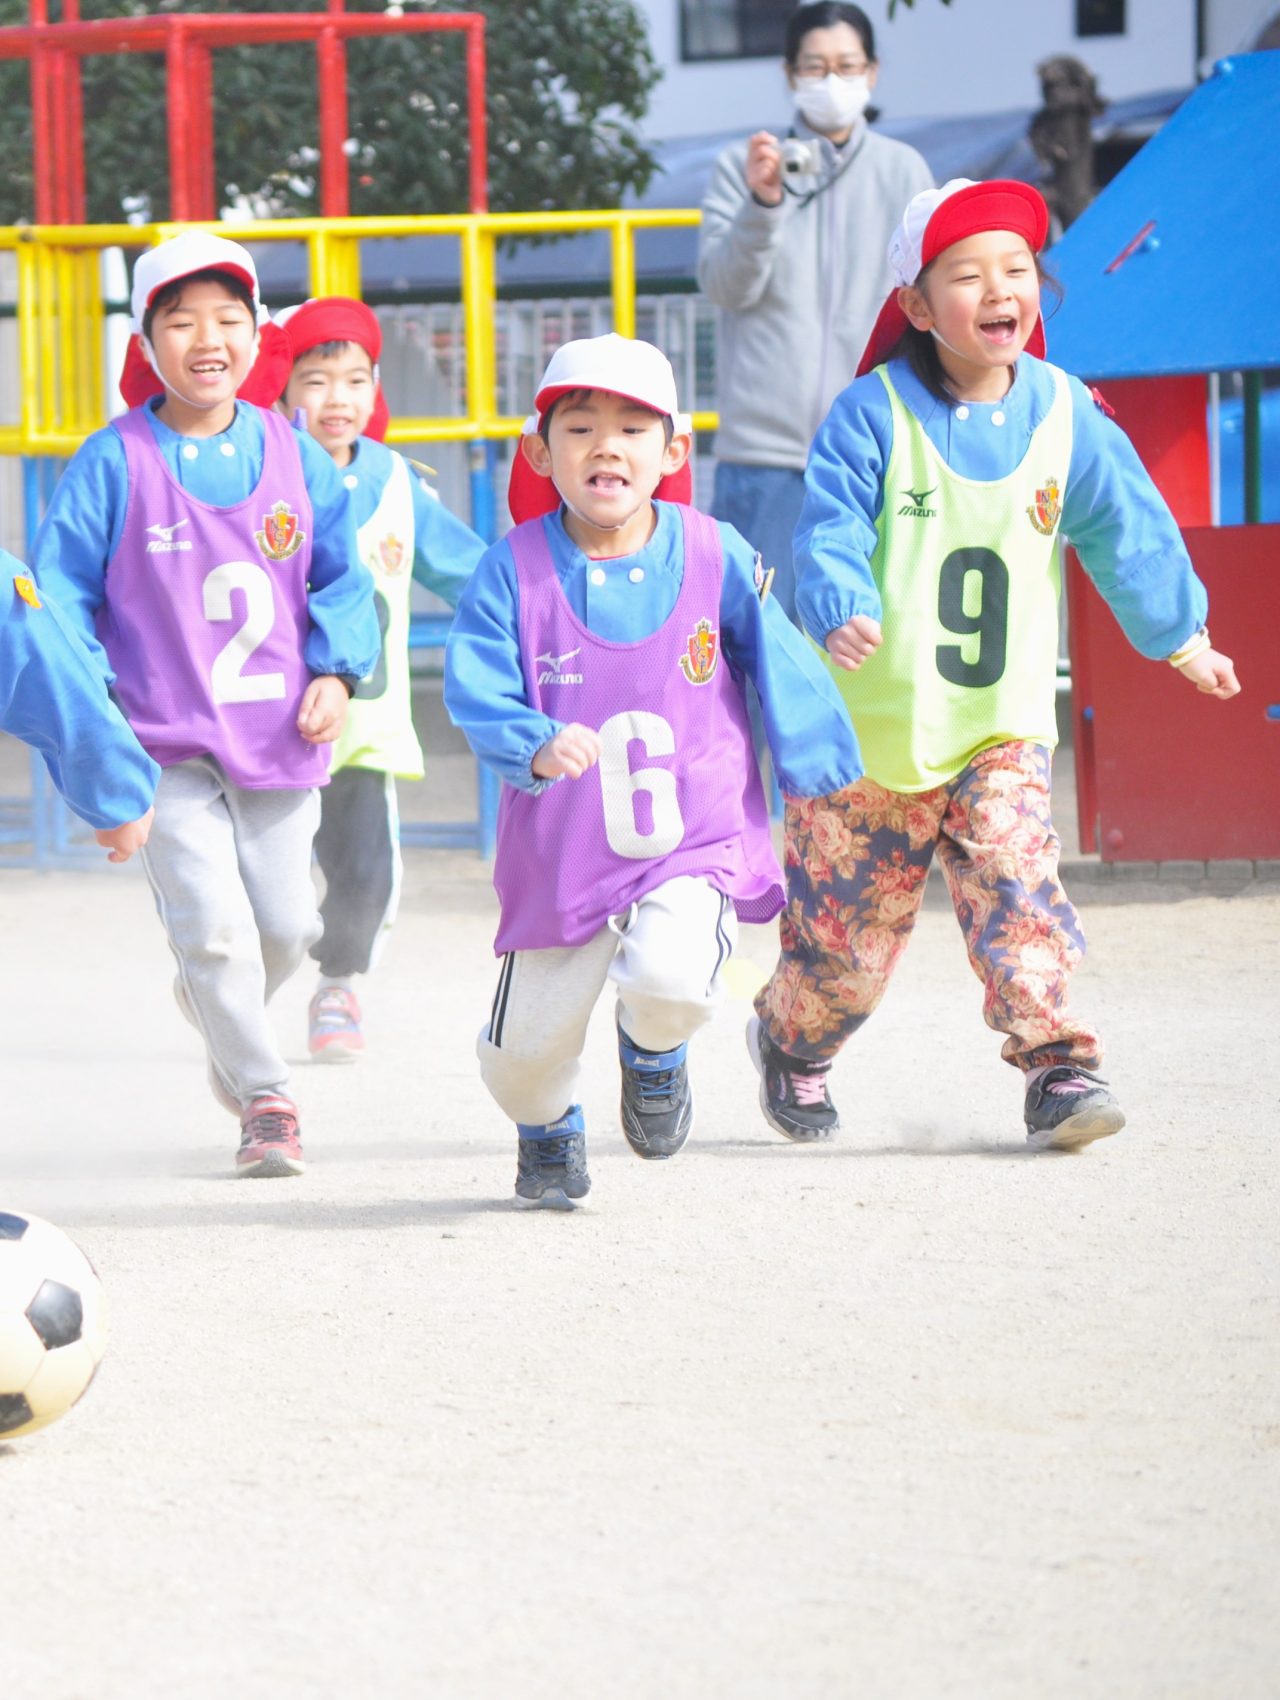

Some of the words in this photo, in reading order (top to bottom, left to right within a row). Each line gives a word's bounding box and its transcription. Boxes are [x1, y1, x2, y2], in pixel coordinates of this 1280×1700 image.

[202, 560, 287, 705] 2
[936, 546, 1010, 688] 9
[598, 710, 685, 860] 6
